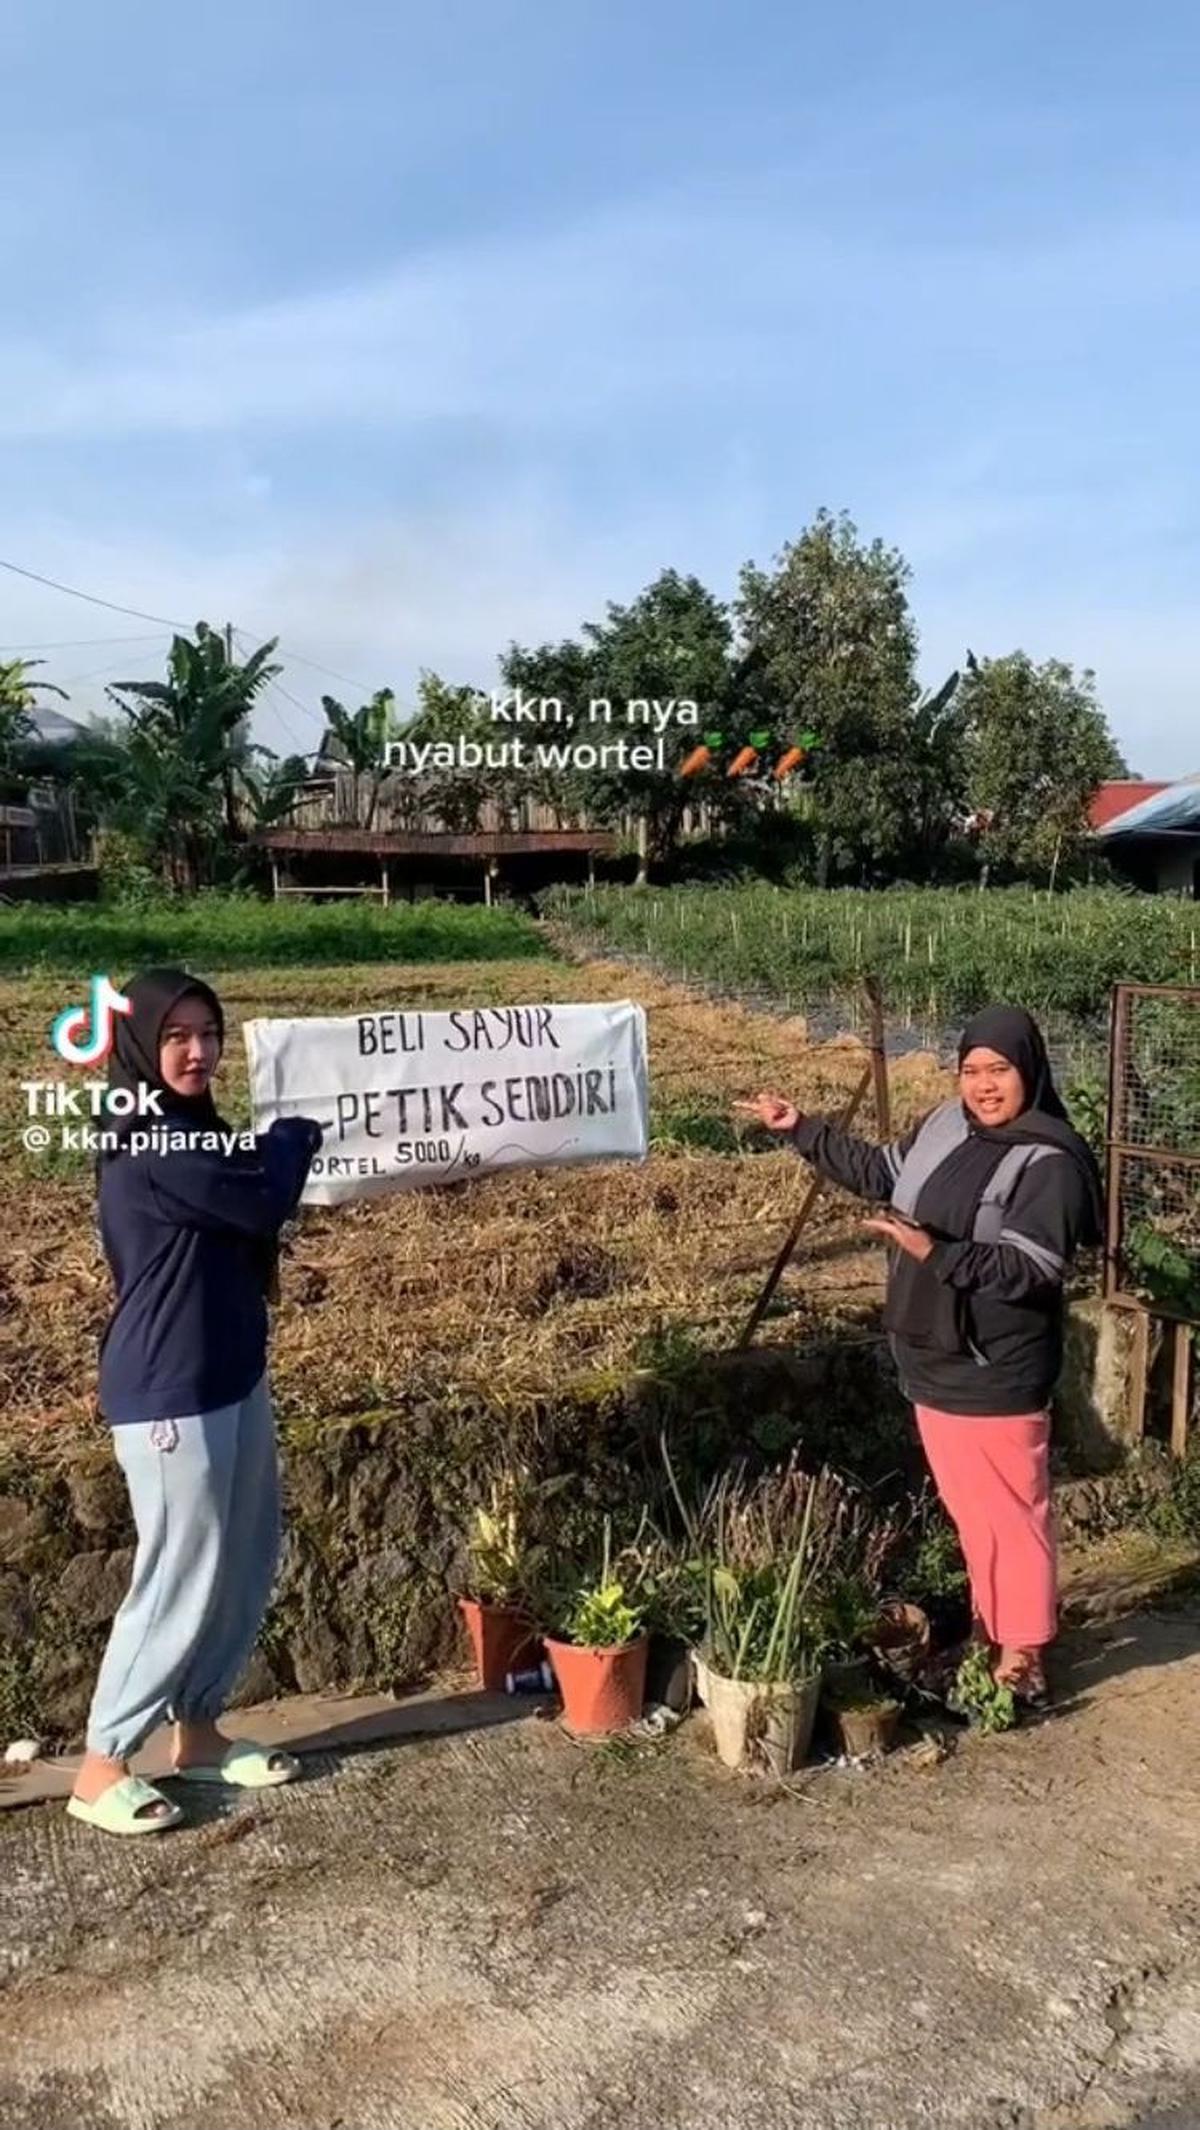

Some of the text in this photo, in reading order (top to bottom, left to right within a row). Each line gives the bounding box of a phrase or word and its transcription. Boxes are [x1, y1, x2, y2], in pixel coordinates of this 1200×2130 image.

[357, 1007, 560, 1056] BELI SAYUR
[311, 1157, 386, 1176] ORTEL
